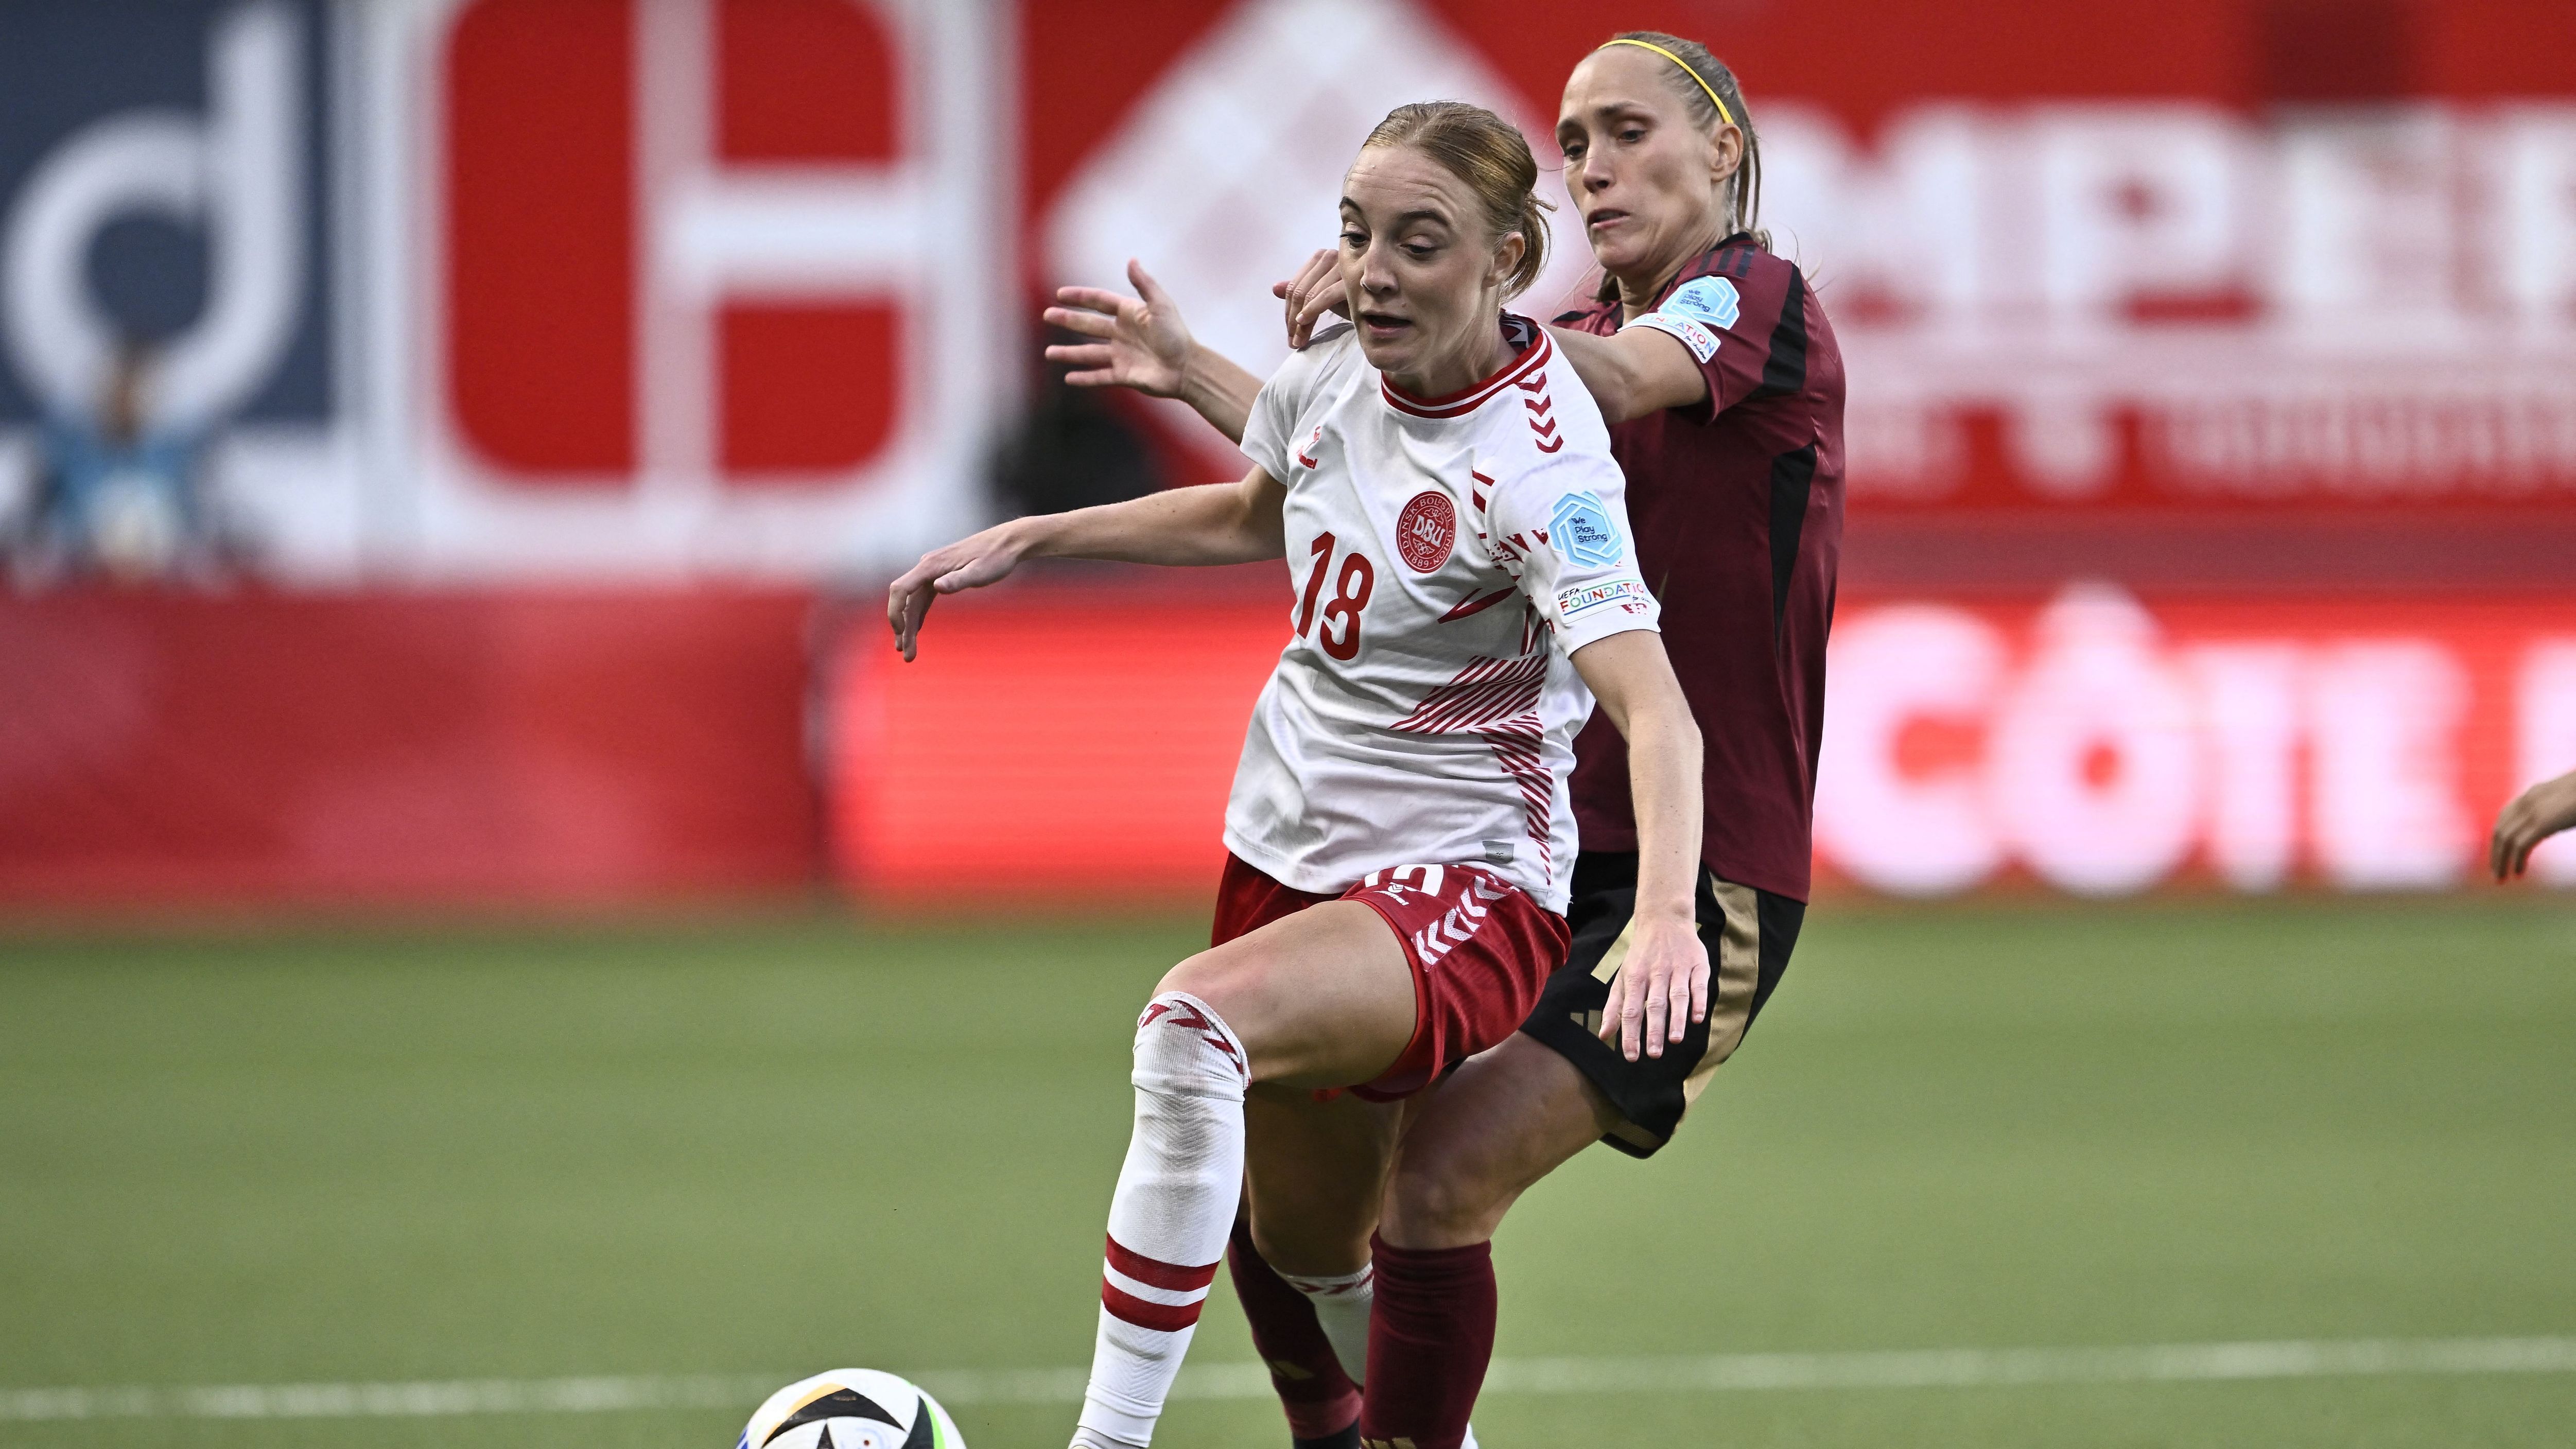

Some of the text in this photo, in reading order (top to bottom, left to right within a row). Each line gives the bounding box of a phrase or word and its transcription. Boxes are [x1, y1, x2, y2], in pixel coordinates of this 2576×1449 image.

[1401, 507, 1418, 549] DANSK
[1412, 514, 1446, 548] DBU
[1575, 525, 1595, 534] Play
[1577, 533, 1608, 543] Strong
[1407, 552, 1430, 568] 1889
[1433, 530, 1453, 565] UNION
[1296, 531, 1374, 661] 18
[1558, 588, 1580, 601] UEFA
